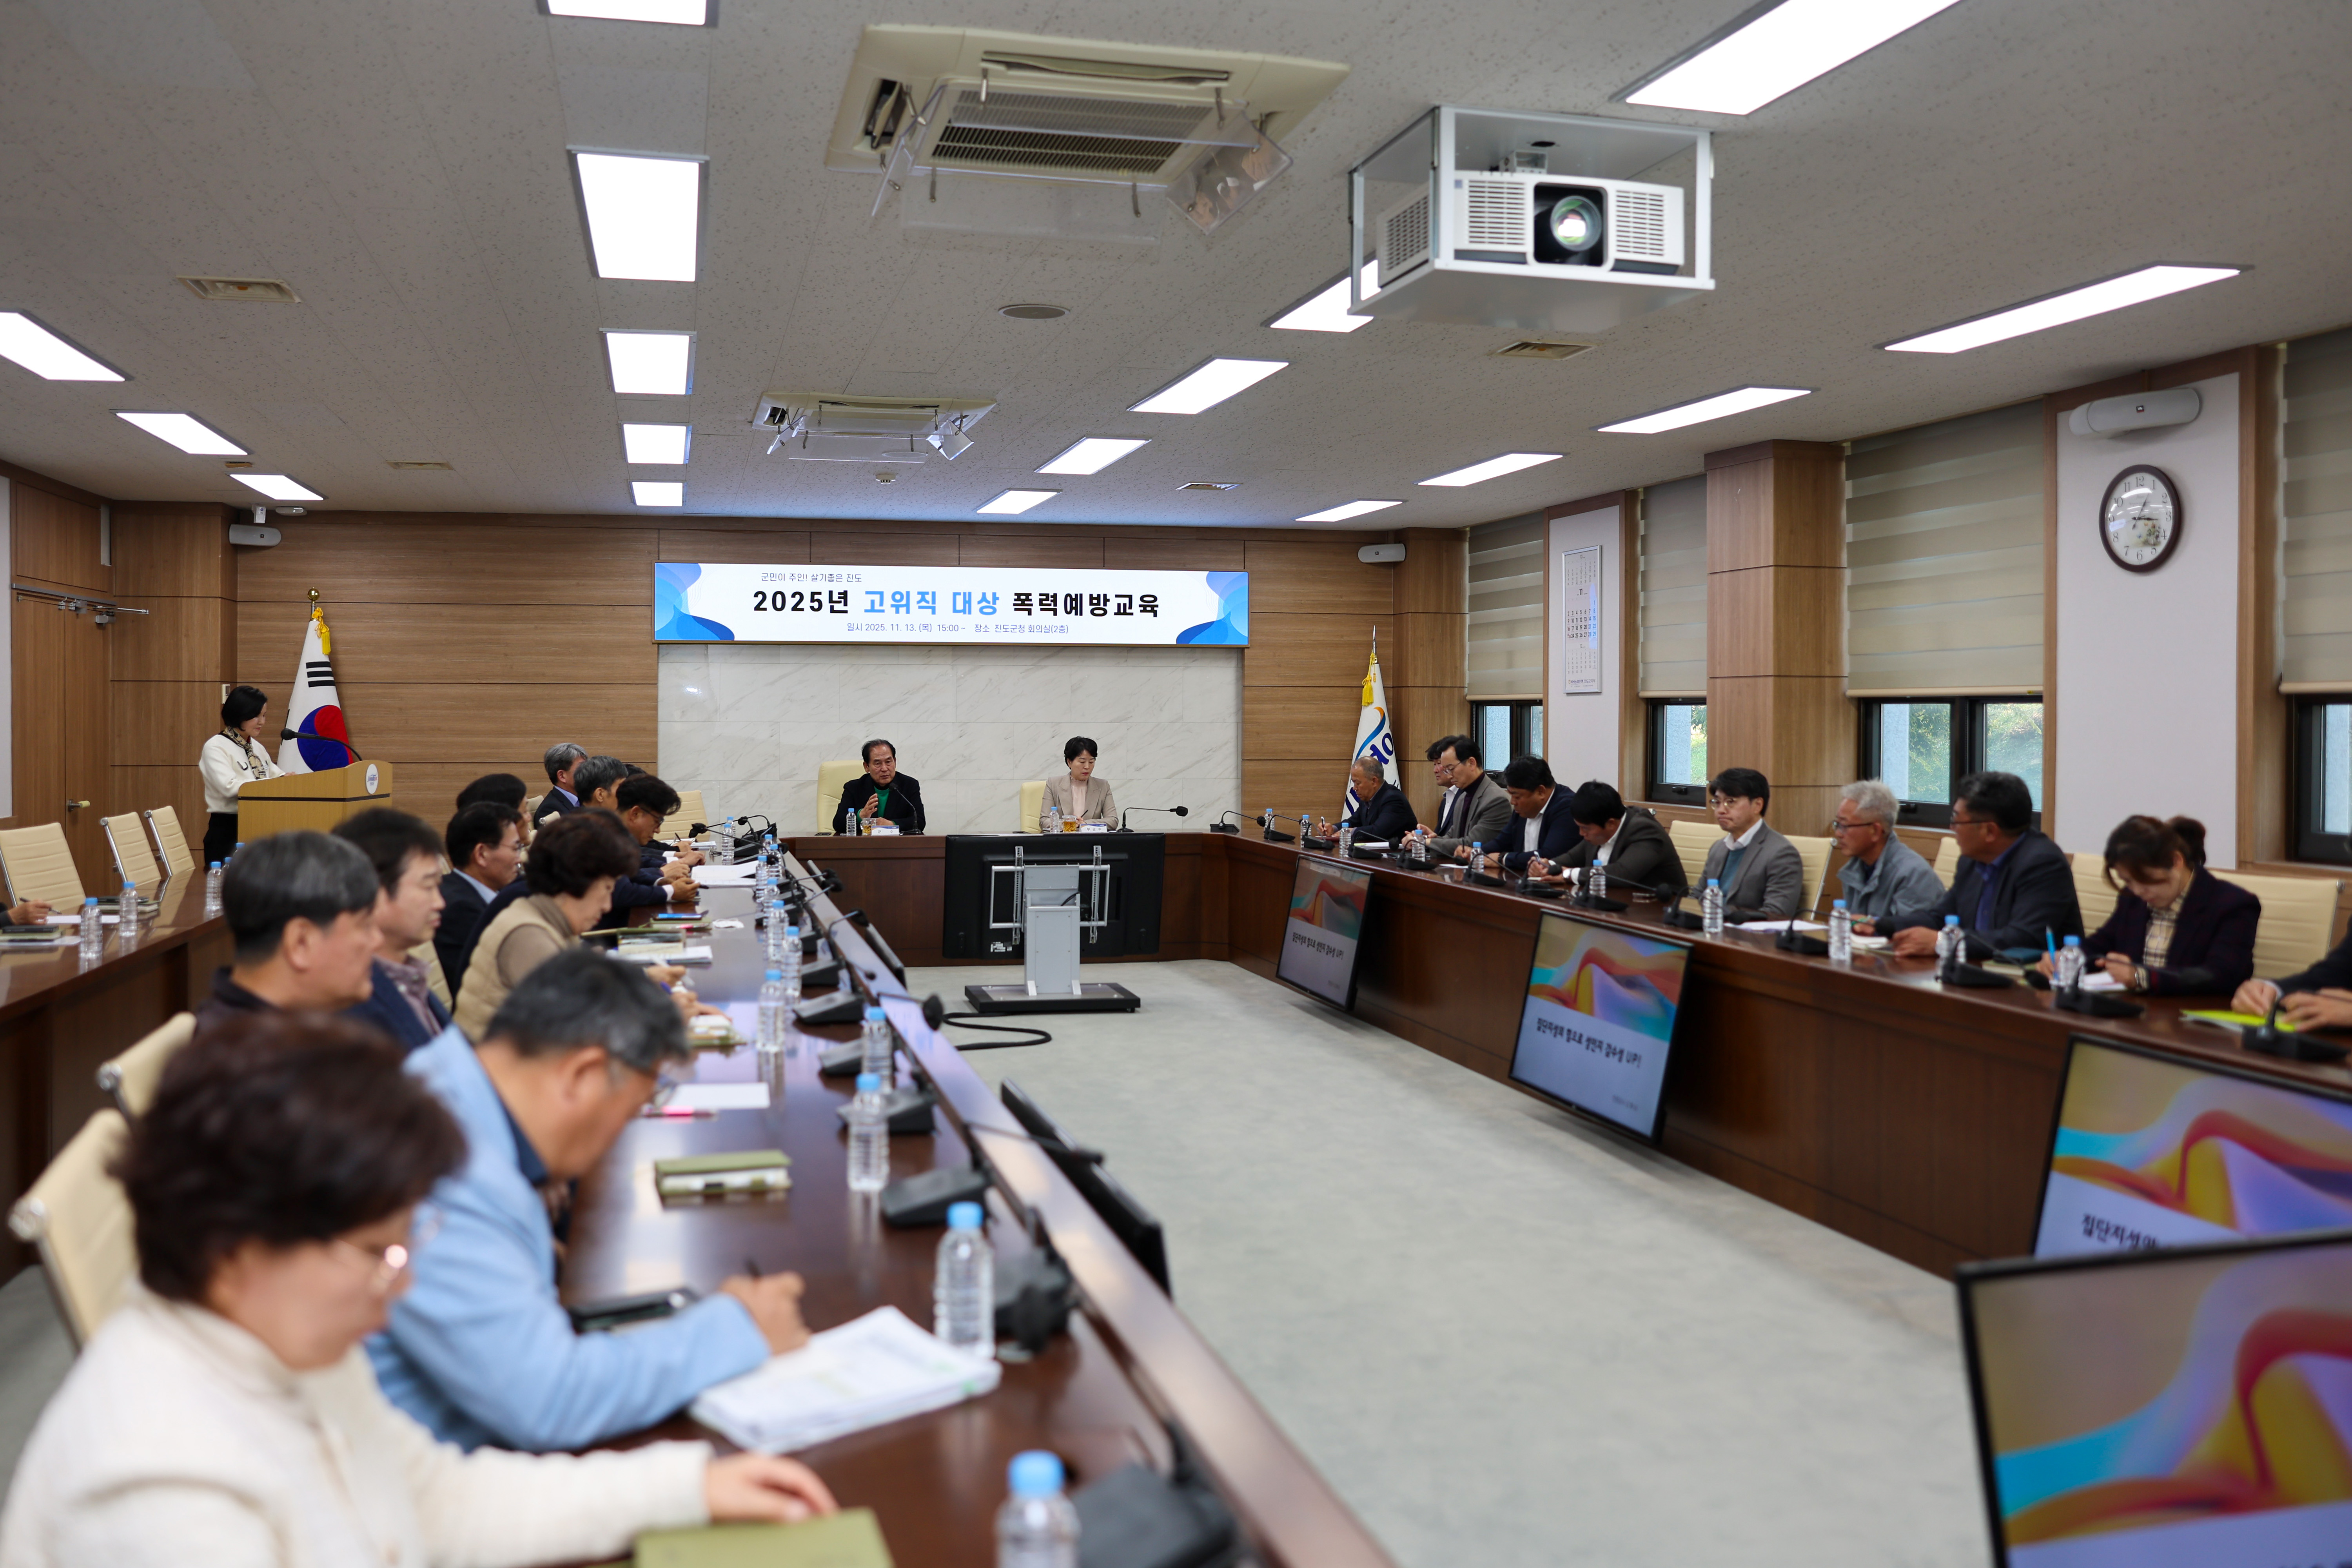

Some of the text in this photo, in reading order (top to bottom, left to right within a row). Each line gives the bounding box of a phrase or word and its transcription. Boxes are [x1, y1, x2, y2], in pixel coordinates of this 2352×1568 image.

[2124, 482, 2130, 492] 11
[2136, 476, 2144, 487] 12
[2152, 480, 2155, 490] 1
[2114, 497, 2123, 507] 10
[2162, 493, 2167, 504] 2
[2166, 511, 2171, 522] 3
[2113, 532, 2118, 543] 8
[2161, 529, 2167, 540] 4
[2124, 546, 2129, 556] 7
[2137, 550, 2143, 561] 6
[811, 573, 842, 582] 살기좋은
[753, 590, 1159, 617] 2025년 고위직 대상 폭력예방교육
[847, 623, 862, 631] 일시
[919, 623, 932, 632] (목)
[995, 624, 1025, 633] 진도군청
[1028, 625, 1068, 633] 회의실(2층)
